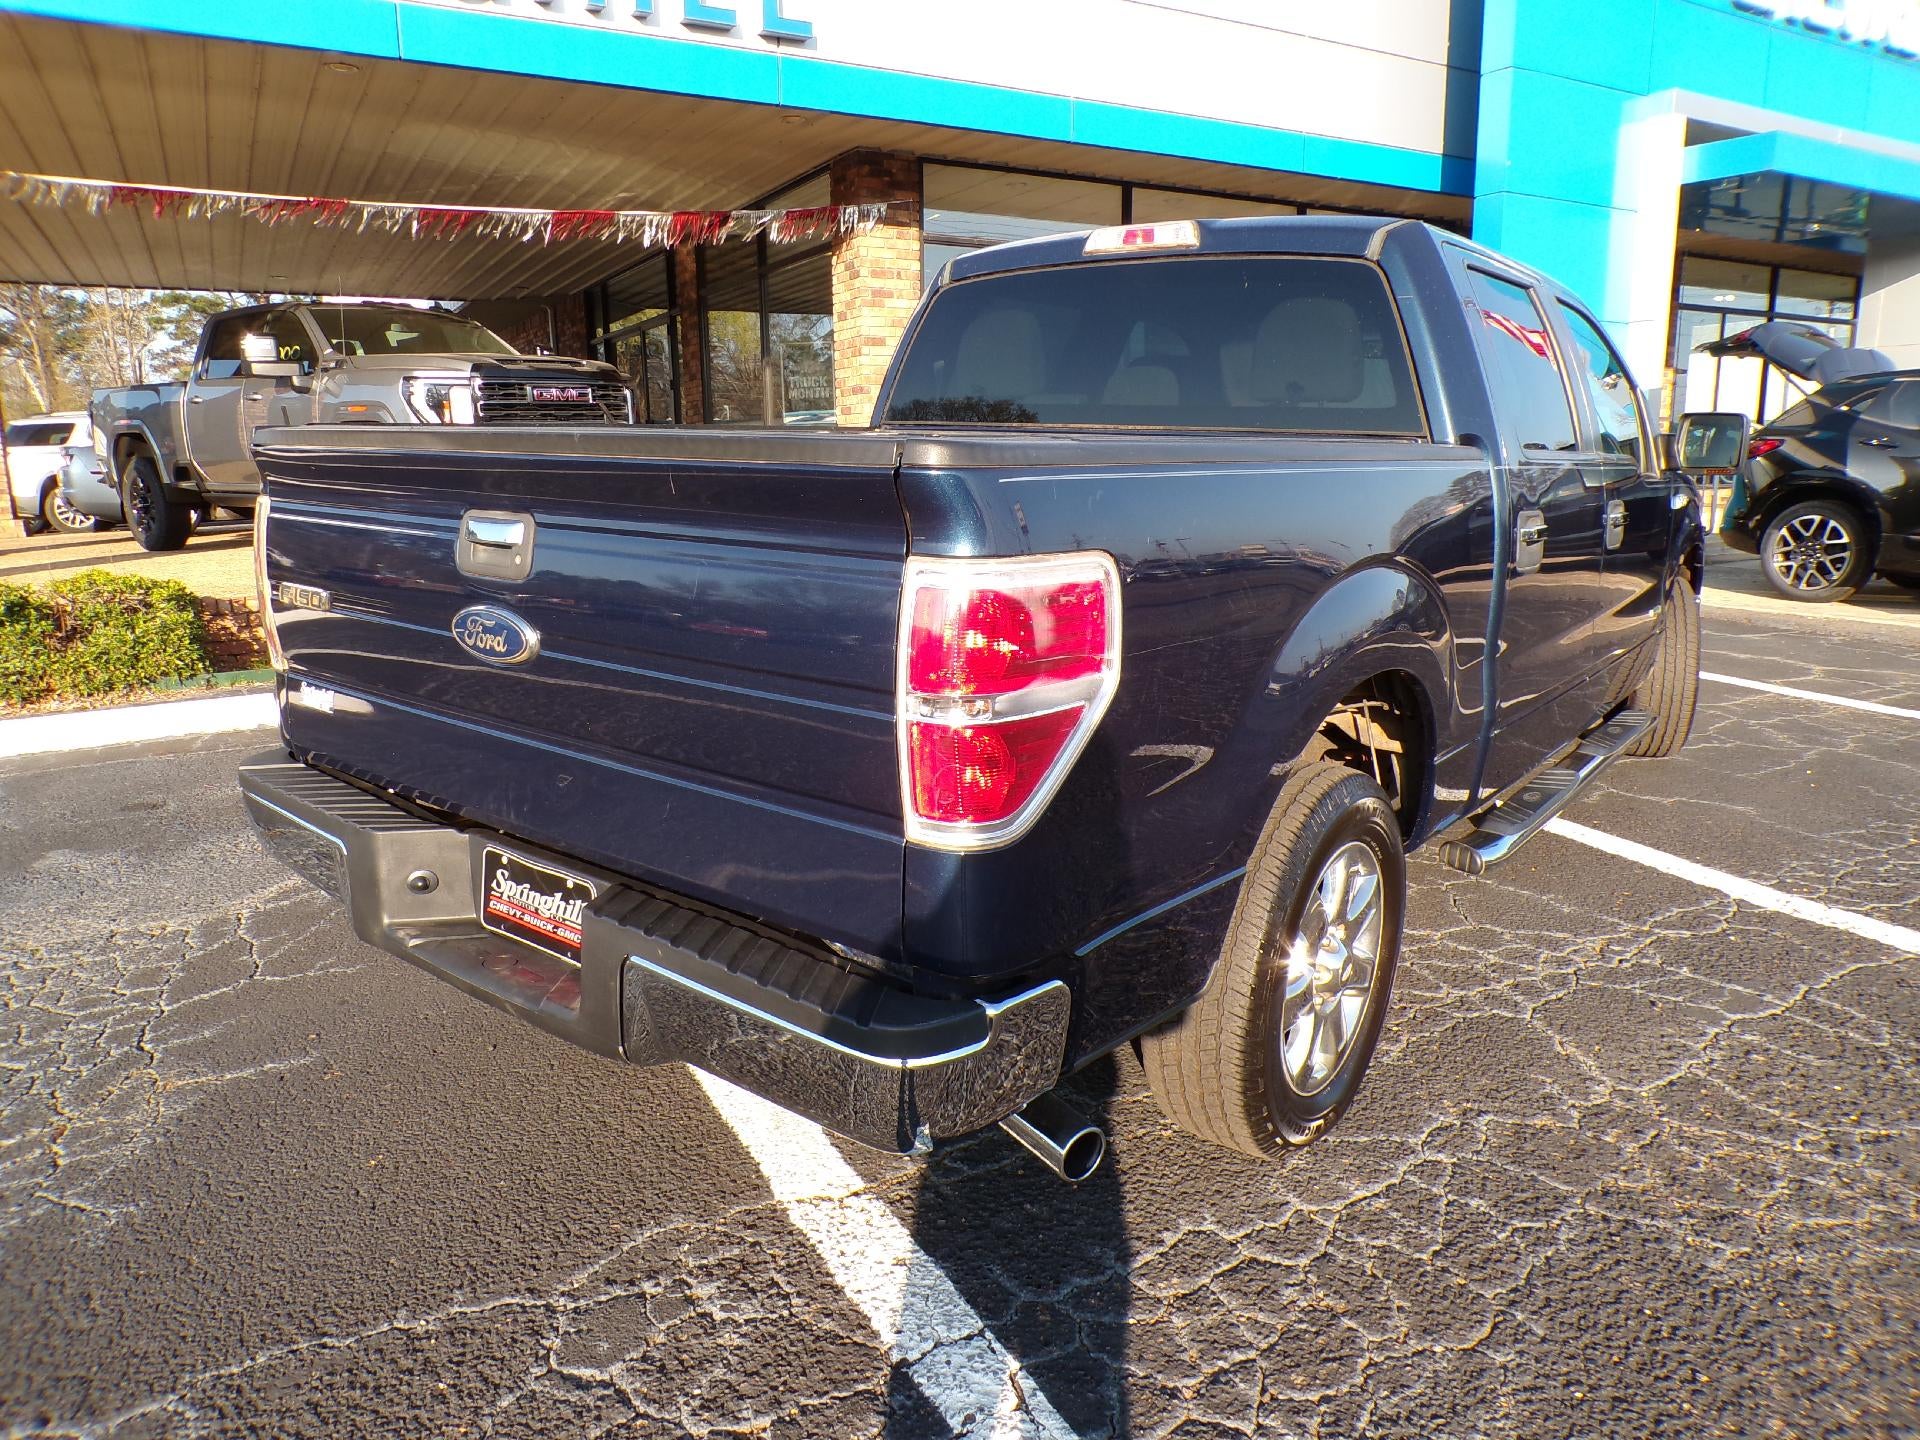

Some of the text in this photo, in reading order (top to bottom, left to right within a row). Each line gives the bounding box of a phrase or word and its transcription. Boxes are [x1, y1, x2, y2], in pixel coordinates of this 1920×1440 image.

[789, 376, 827, 388] TRUCK
[534, 388, 590, 402] GMC
[789, 387, 830, 399] MONTH
[464, 616, 507, 652] Ford
[510, 896, 536, 913] MOTOR
[488, 900, 581, 943] CHEVY-BUICK-GMC
